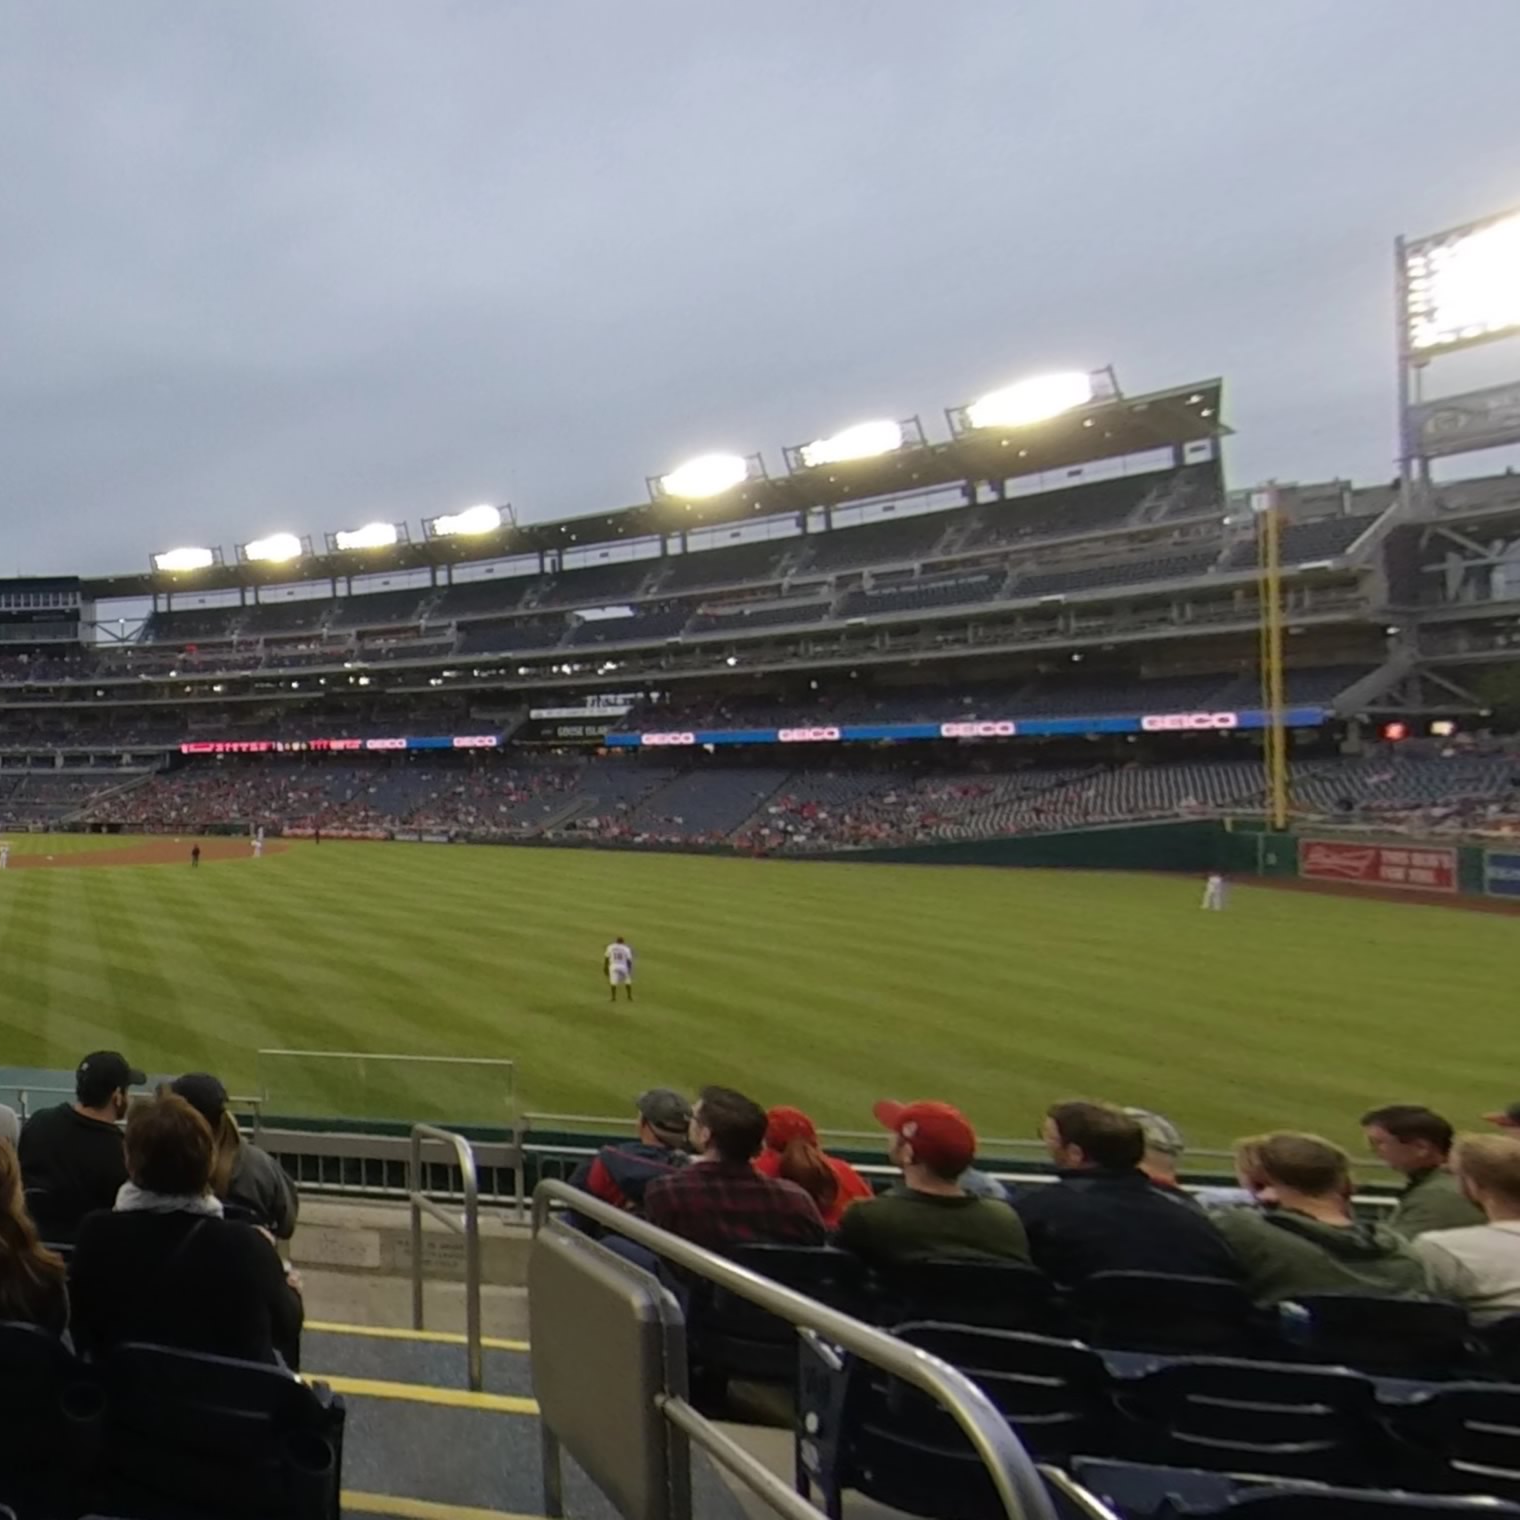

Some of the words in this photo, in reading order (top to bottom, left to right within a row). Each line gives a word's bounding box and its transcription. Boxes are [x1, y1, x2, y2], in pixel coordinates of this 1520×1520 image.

[941, 721, 1016, 737] GEICO
[1142, 712, 1238, 730] GEICO
[779, 726, 840, 741] GEICO
